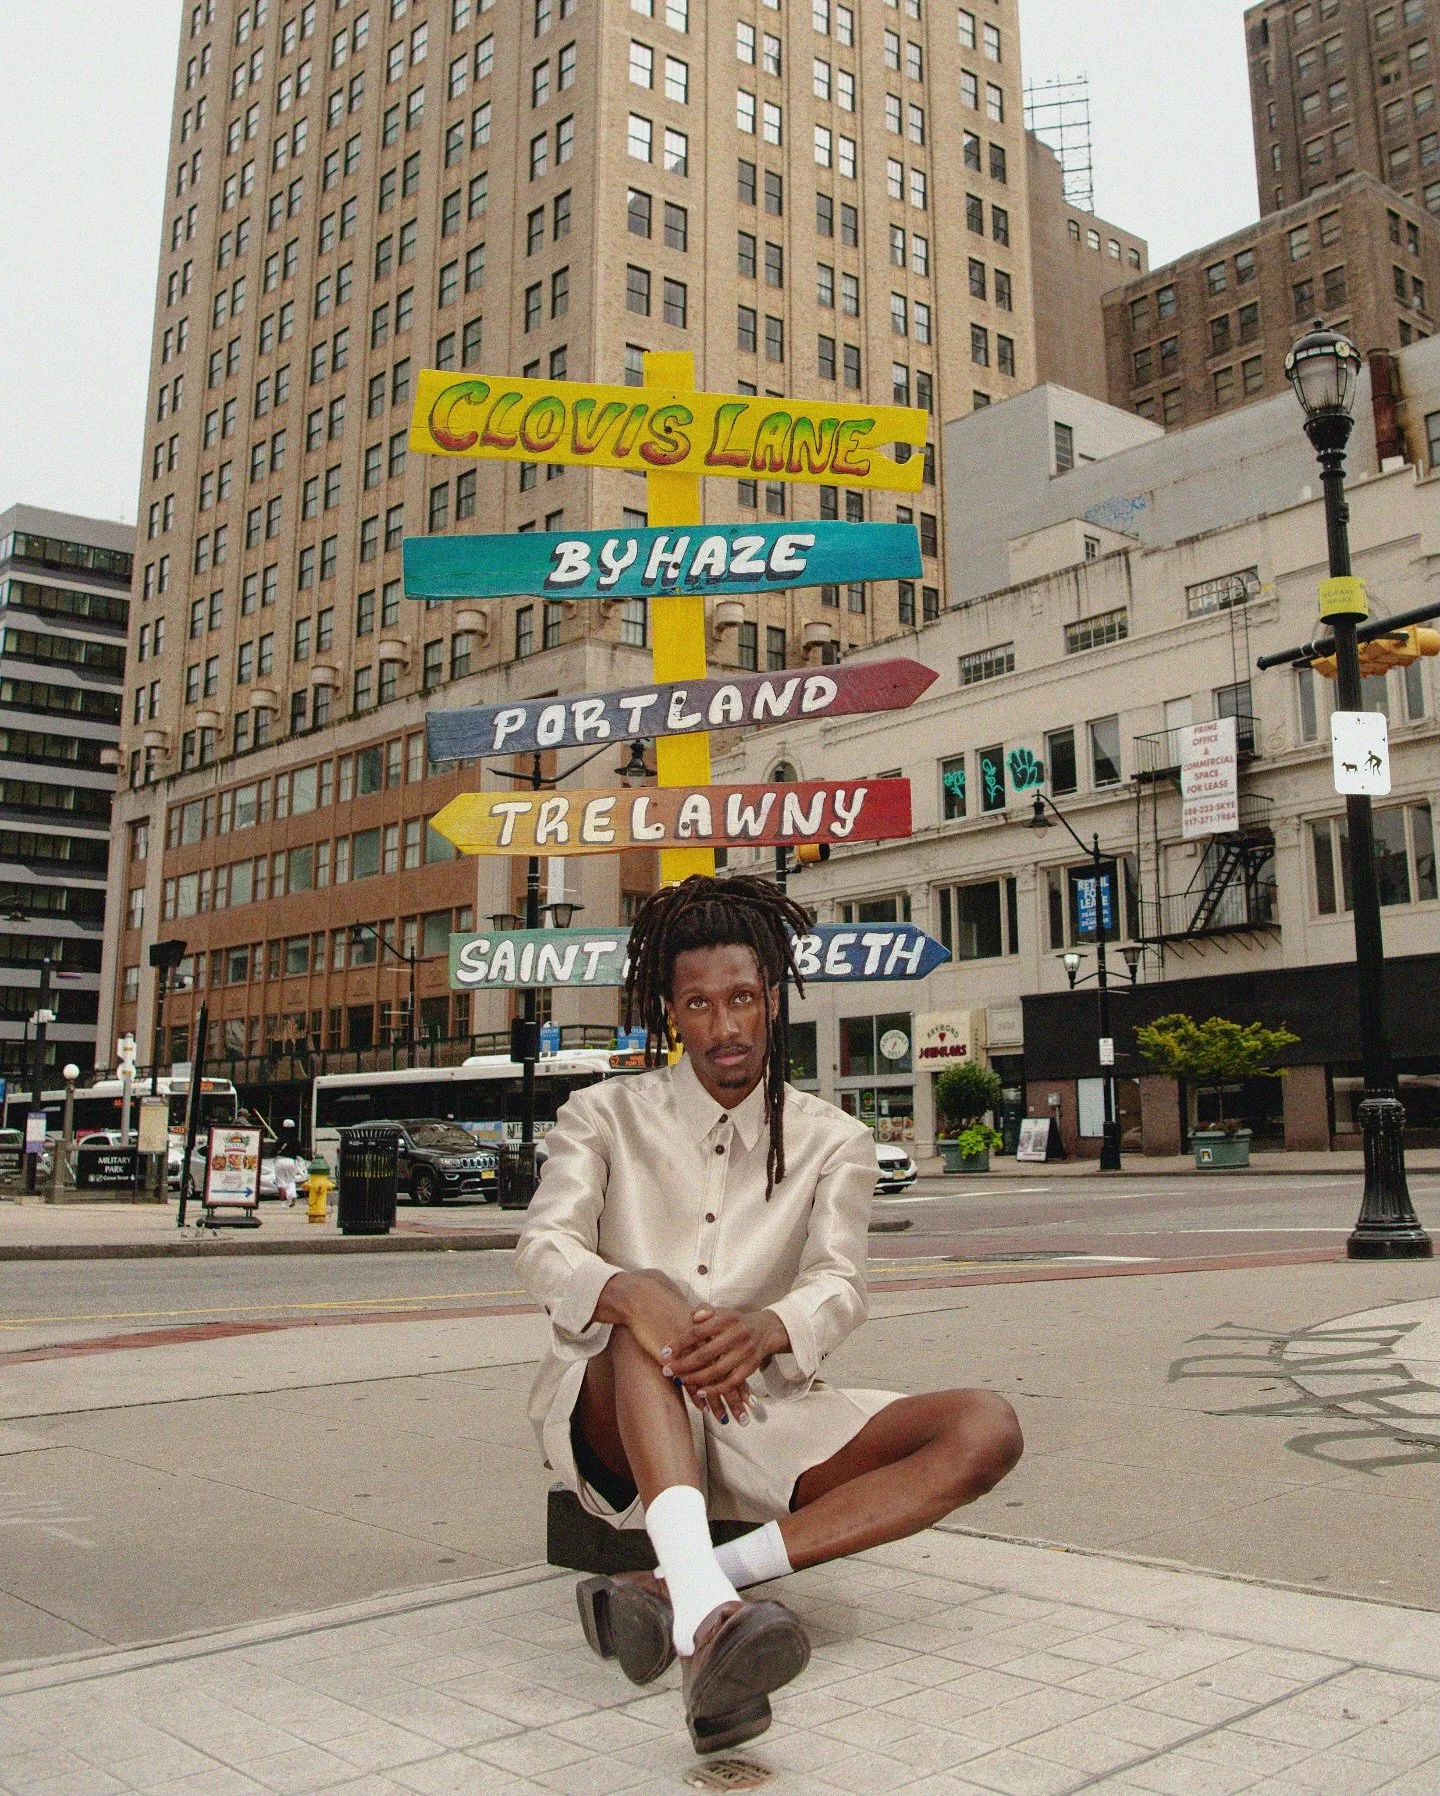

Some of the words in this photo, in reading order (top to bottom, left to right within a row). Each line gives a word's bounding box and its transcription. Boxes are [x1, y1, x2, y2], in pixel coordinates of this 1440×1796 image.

[428, 380, 693, 466] CLOVIS
[704, 402, 876, 477] LANE
[545, 539, 638, 590] BY
[641, 533, 816, 586] HAZE
[492, 675, 839, 750] PORTLAND
[1194, 722, 1218, 734] PRIME
[1192, 734, 1219, 746] OFFICE
[1203, 747, 1210, 756] &
[1182, 755, 1234, 772] COMMERCIAL
[1194, 769, 1220, 781] SPACE
[1187, 783, 1203, 794] FOR
[1204, 780, 1229, 792] LEASE
[491, 787, 869, 846] TRELAWNY
[1077, 876, 1110, 891] RETIL
[1080, 896, 1109, 909] LEAE
[456, 938, 618, 983] SAINT
[98, 1156, 132, 1165] MILITARY
[104, 1165, 124, 1174] PARK
